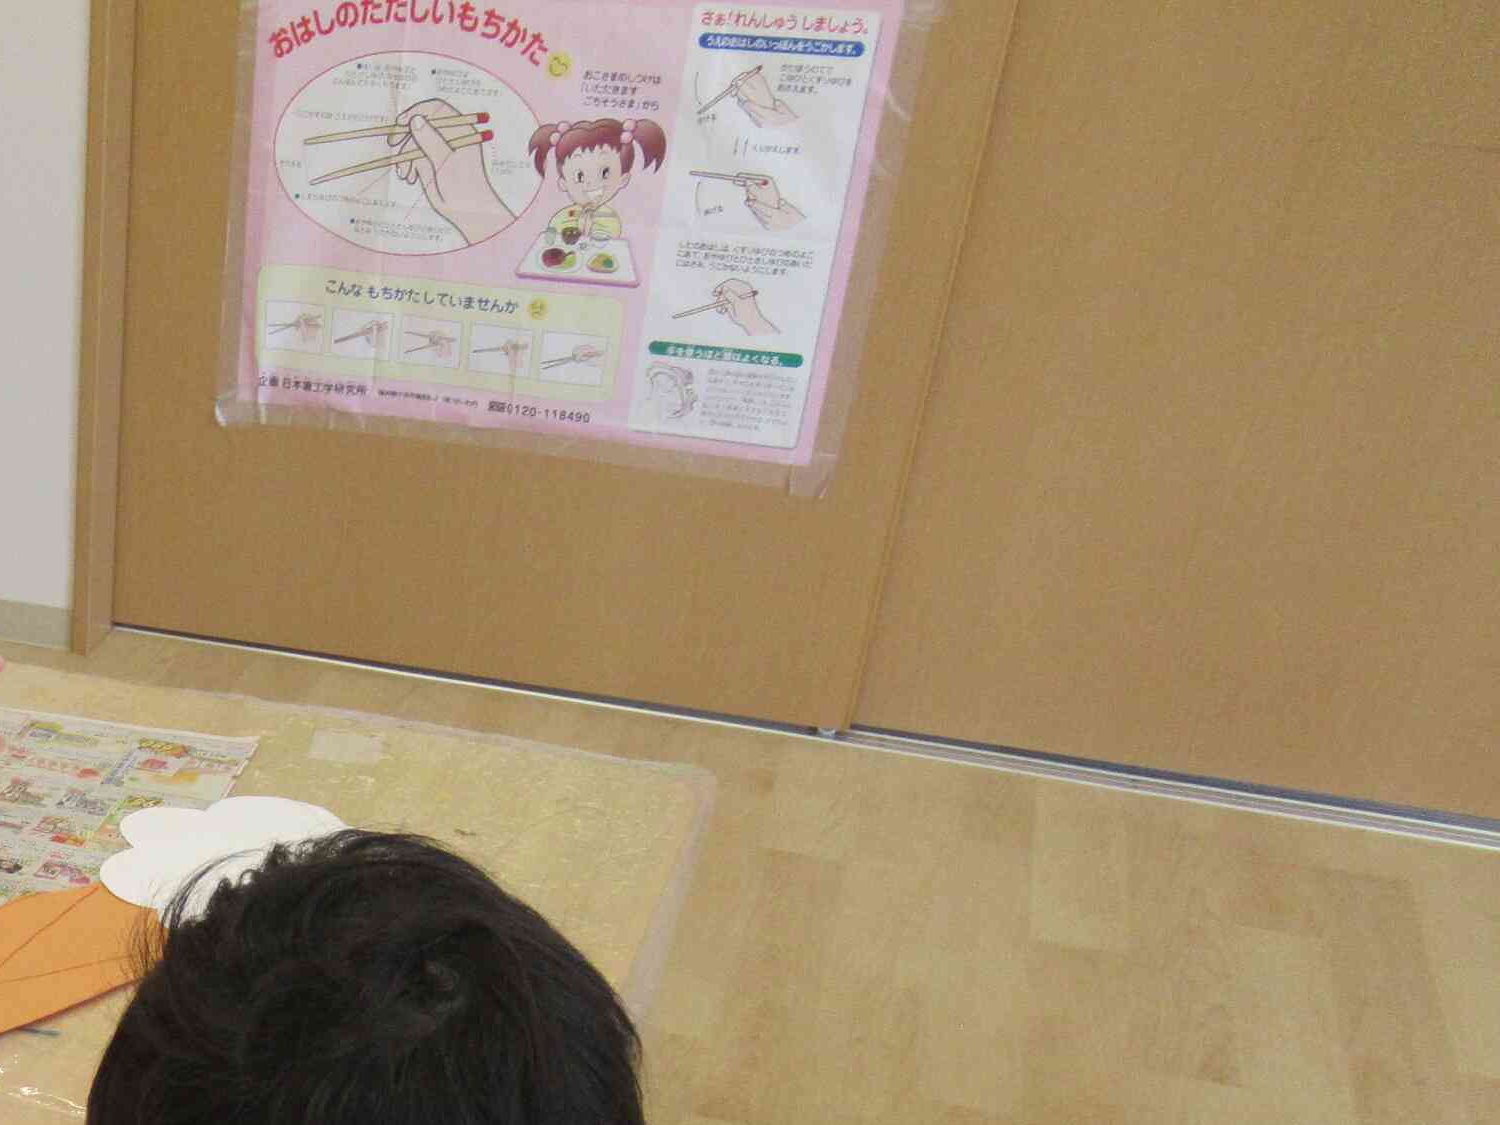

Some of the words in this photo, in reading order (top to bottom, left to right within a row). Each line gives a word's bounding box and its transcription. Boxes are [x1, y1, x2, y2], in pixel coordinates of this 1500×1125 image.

[326, 279, 361, 298] こんな
[506, 404, 590, 423] 0120-118490
